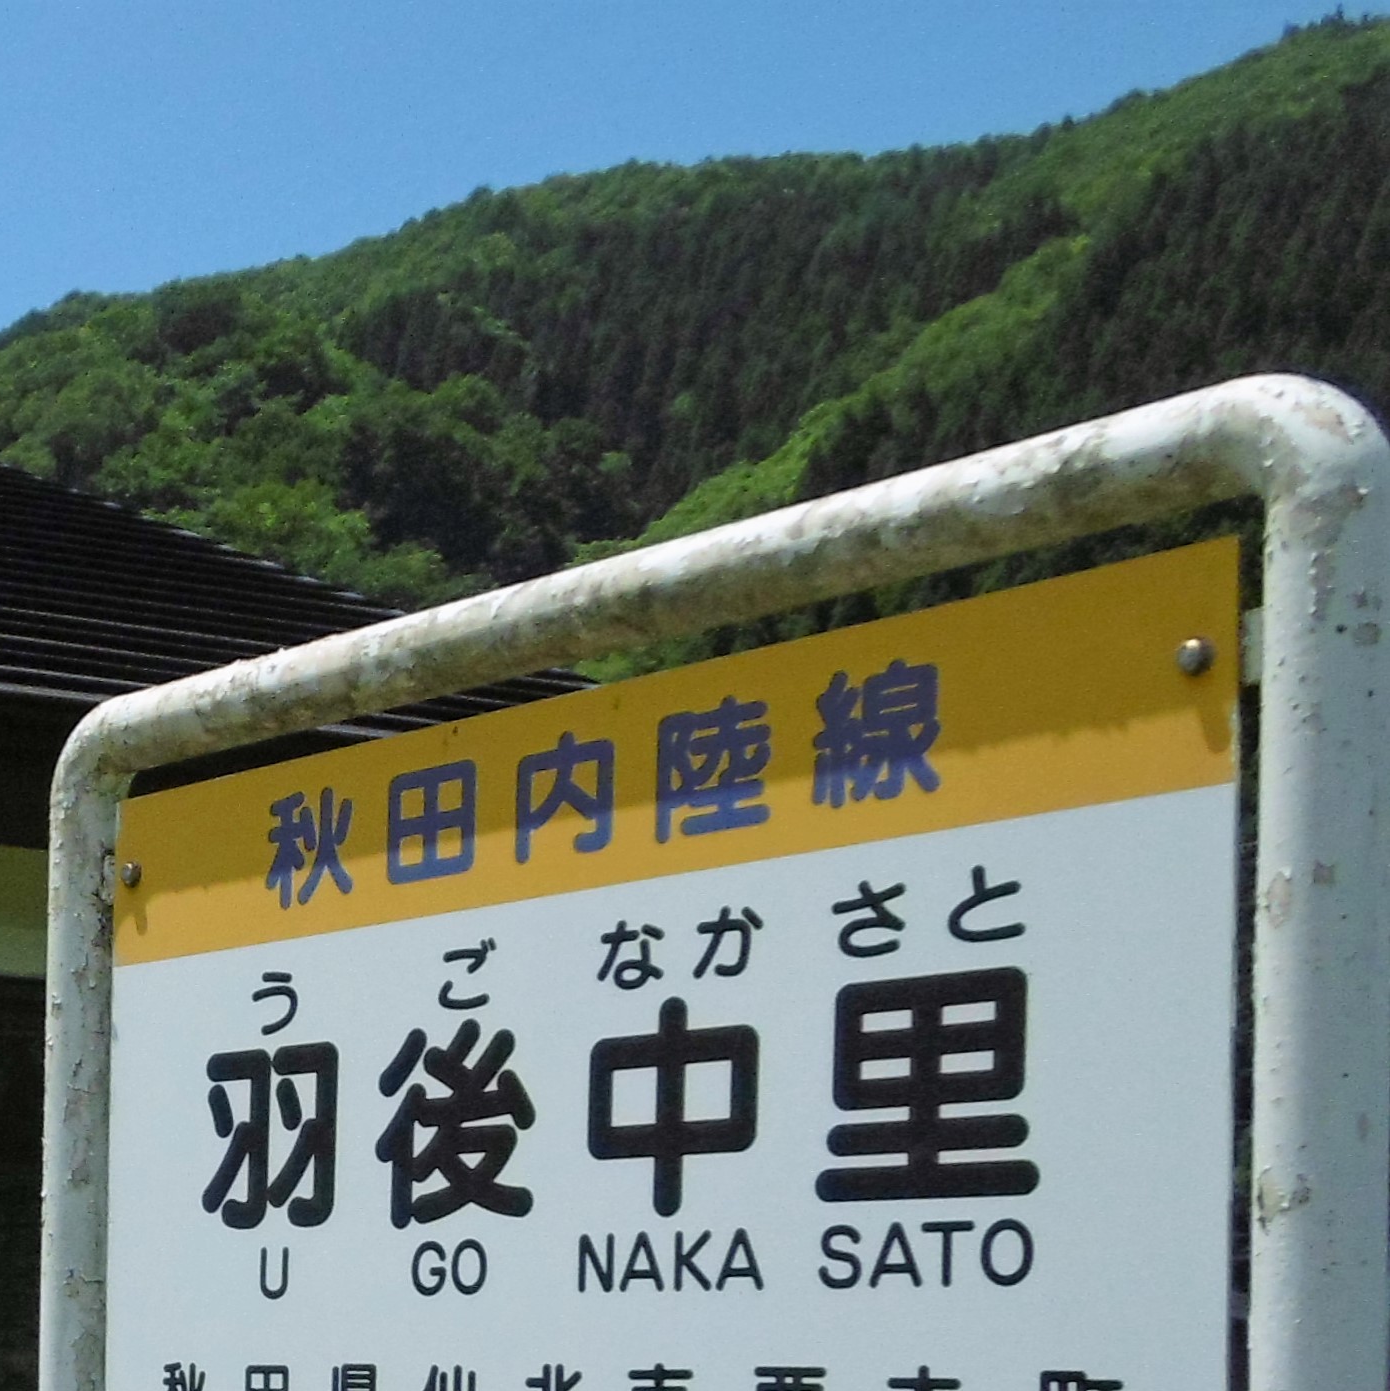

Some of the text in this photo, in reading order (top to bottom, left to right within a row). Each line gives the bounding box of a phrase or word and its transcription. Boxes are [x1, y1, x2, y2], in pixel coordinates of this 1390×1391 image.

[266, 658, 941, 908] 秋田内陸線
[202, 966, 1040, 1229] 羽後中里
[260, 1218, 1034, 1300] U GO NAKA SATO
